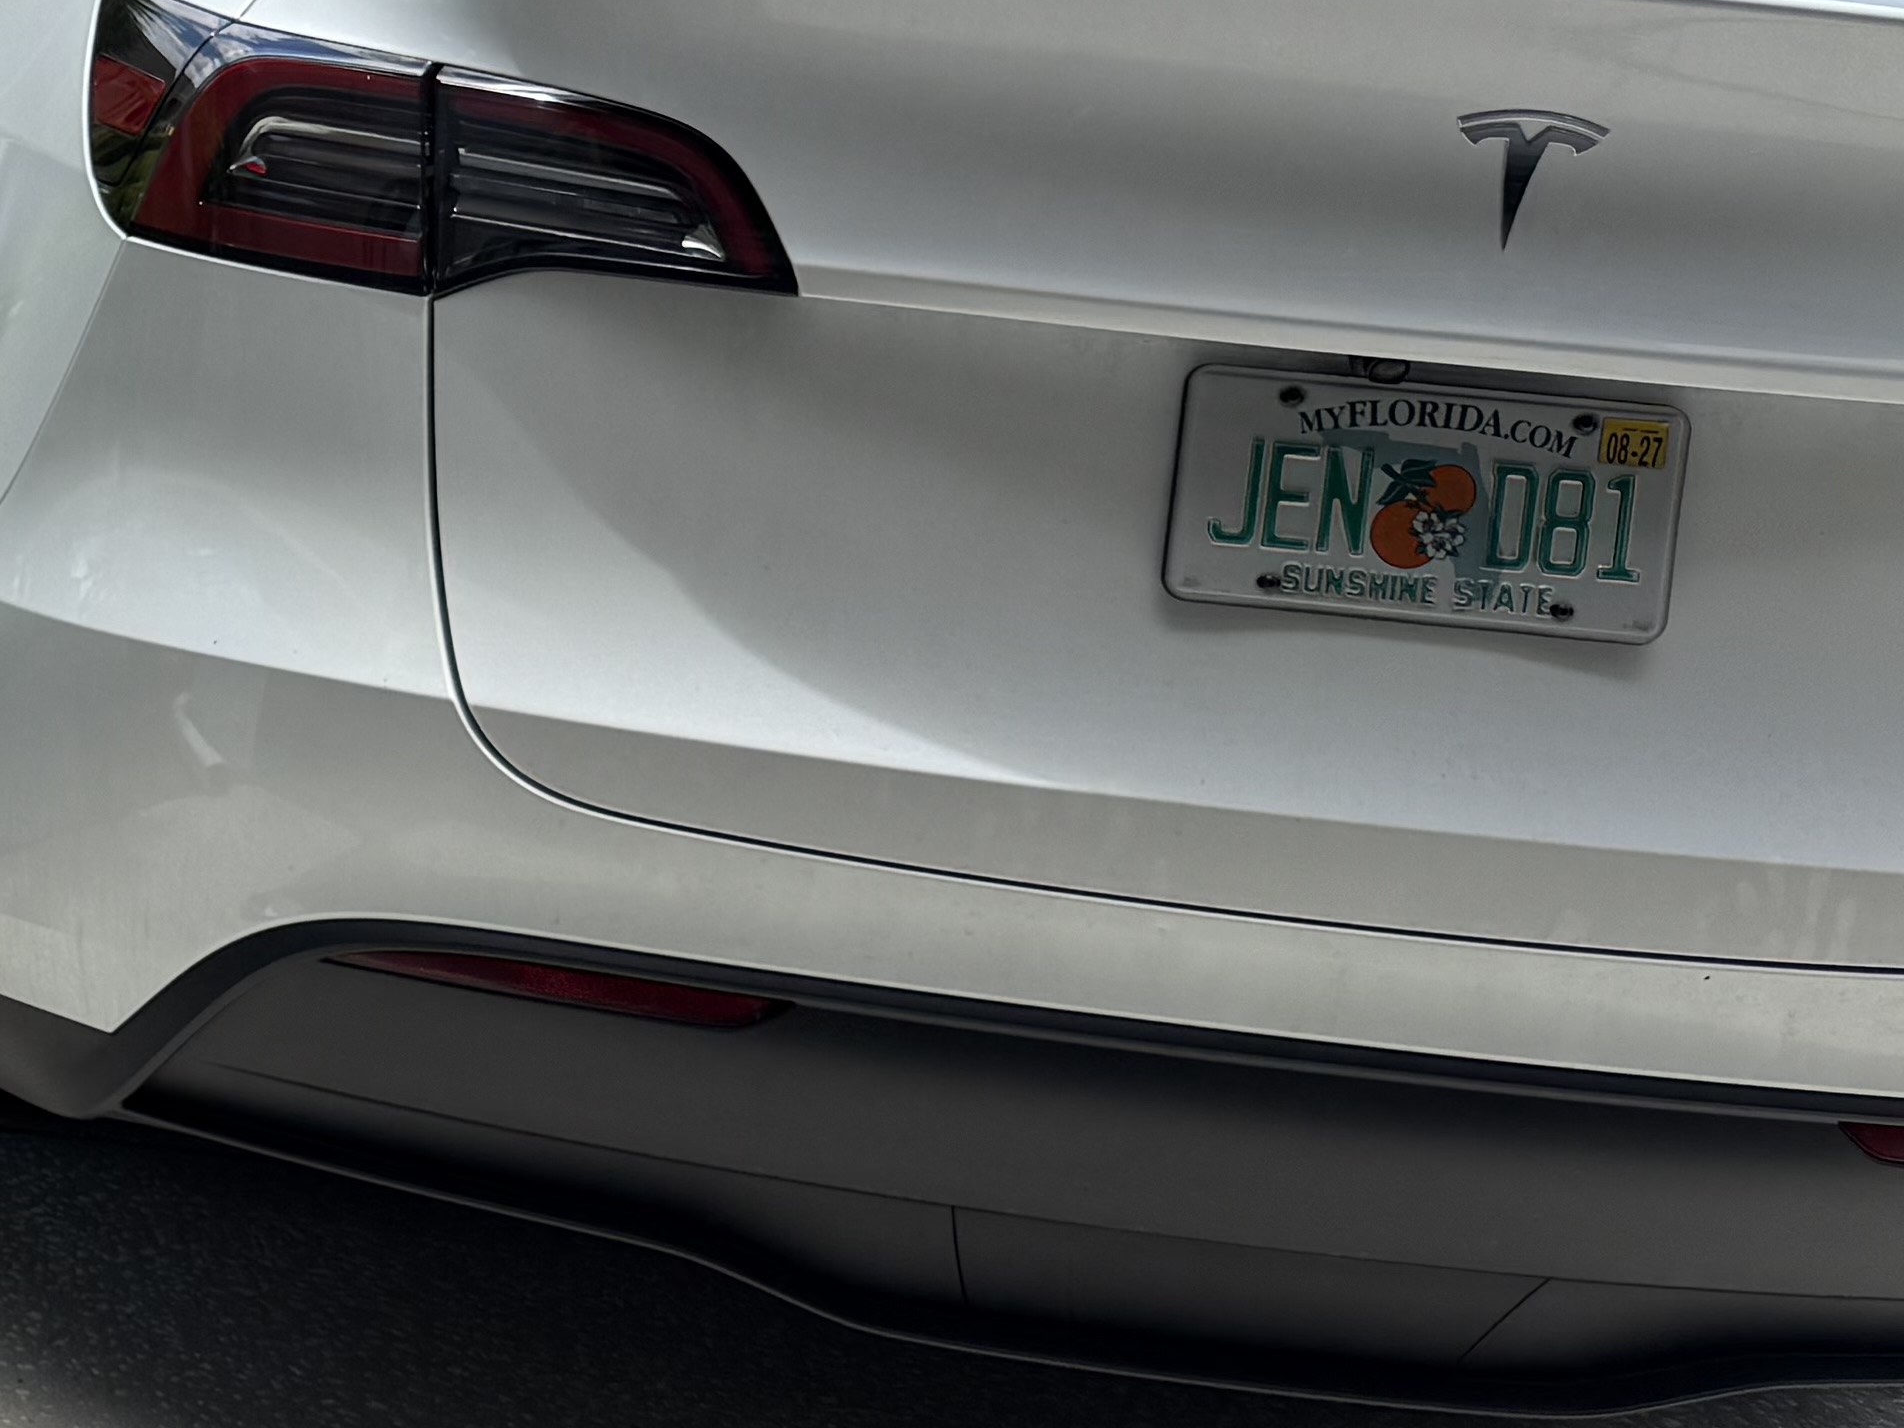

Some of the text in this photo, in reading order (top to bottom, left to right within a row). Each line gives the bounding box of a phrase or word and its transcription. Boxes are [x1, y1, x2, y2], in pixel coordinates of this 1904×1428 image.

[1297, 399, 1579, 459] MYFLORIDA.COM
[1607, 433, 1663, 468] 08-27
[1207, 437, 1639, 583] JEN D81
[1281, 562, 1555, 619] SUNSHINE STATE
